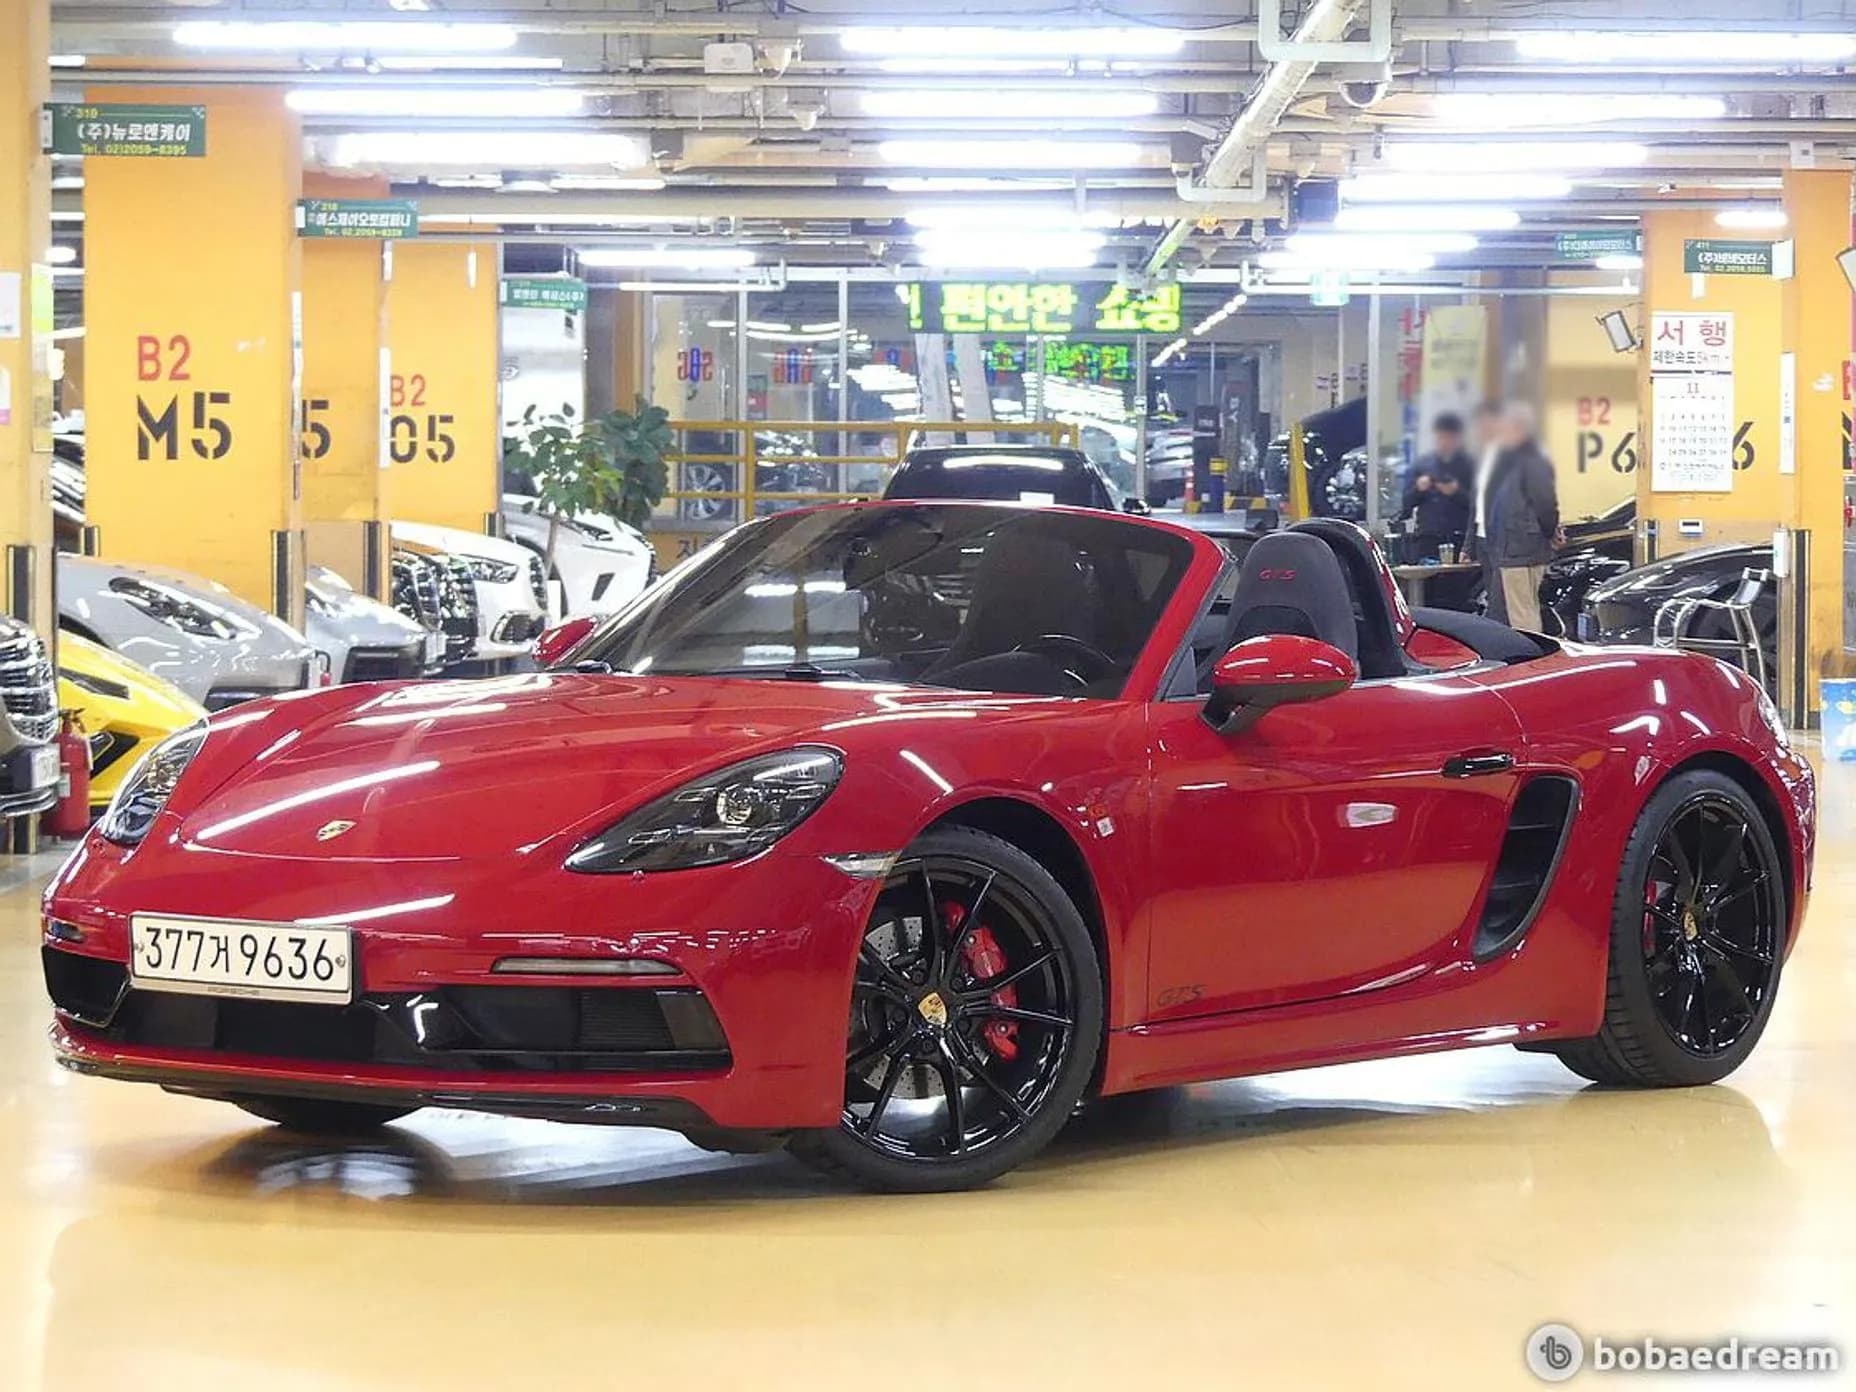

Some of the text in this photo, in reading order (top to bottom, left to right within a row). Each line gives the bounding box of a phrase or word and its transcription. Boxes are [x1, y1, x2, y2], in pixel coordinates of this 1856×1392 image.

[940, 283, 1078, 332] 편안한
[136, 334, 192, 381] B2
[390, 374, 427, 407] B2
[1576, 396, 1612, 426] B2
[137, 391, 232, 460] M5
[1576, 431, 1637, 474] P6
